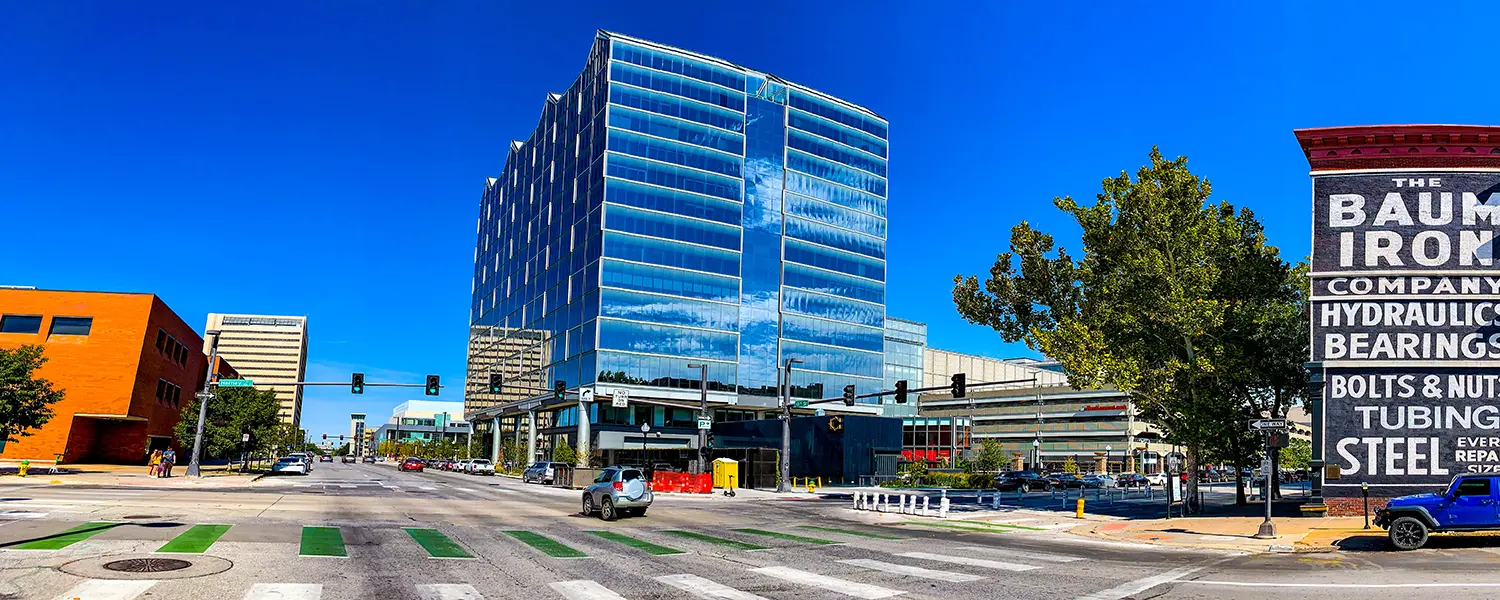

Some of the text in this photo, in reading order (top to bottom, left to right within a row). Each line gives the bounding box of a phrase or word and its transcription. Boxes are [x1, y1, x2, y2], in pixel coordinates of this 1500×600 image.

[1391, 177, 1442, 187] THE
[1340, 230, 1494, 267] IRON
[1331, 374, 1416, 399] BOLTS
[1421, 374, 1443, 400] &
[1354, 405, 1500, 430] TUBING
[1335, 437, 1450, 476] STEEL
